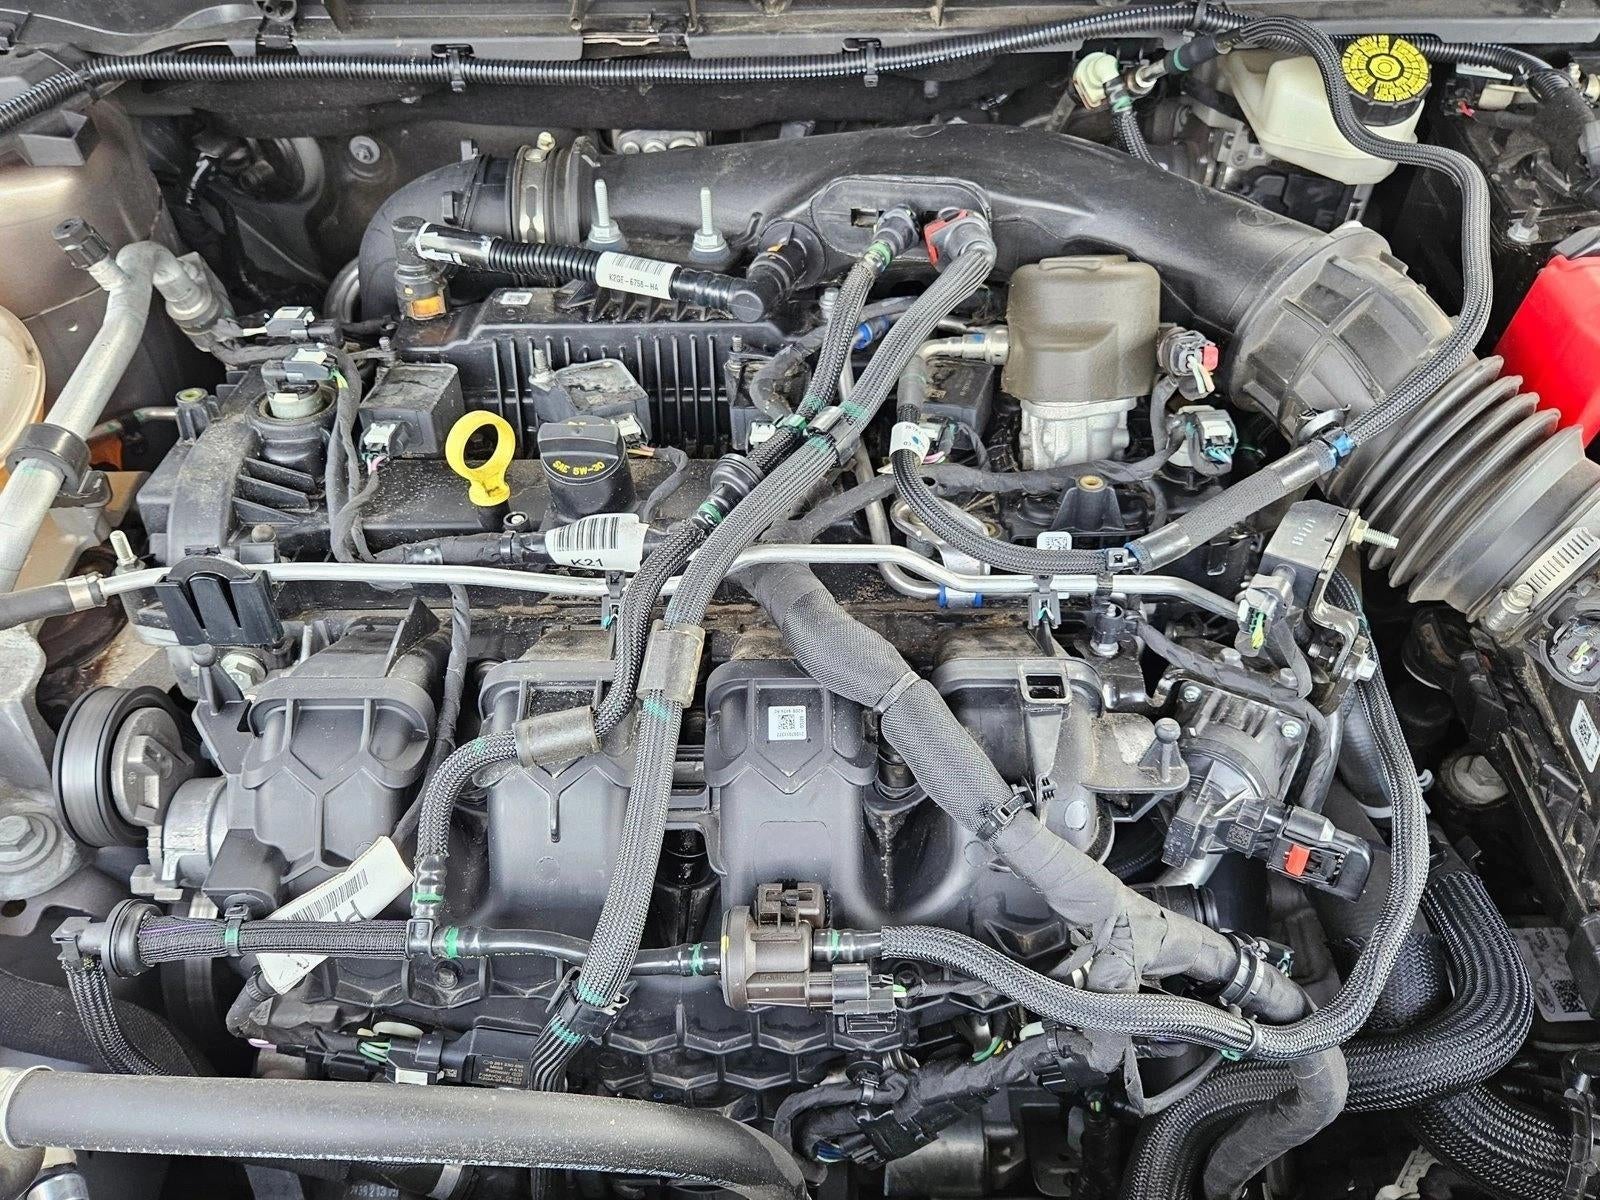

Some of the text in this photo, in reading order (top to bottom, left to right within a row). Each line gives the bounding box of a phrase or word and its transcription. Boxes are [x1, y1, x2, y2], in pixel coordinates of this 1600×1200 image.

[552, 460, 606, 476] SAE 5W-30
[570, 558, 604, 567] K21
